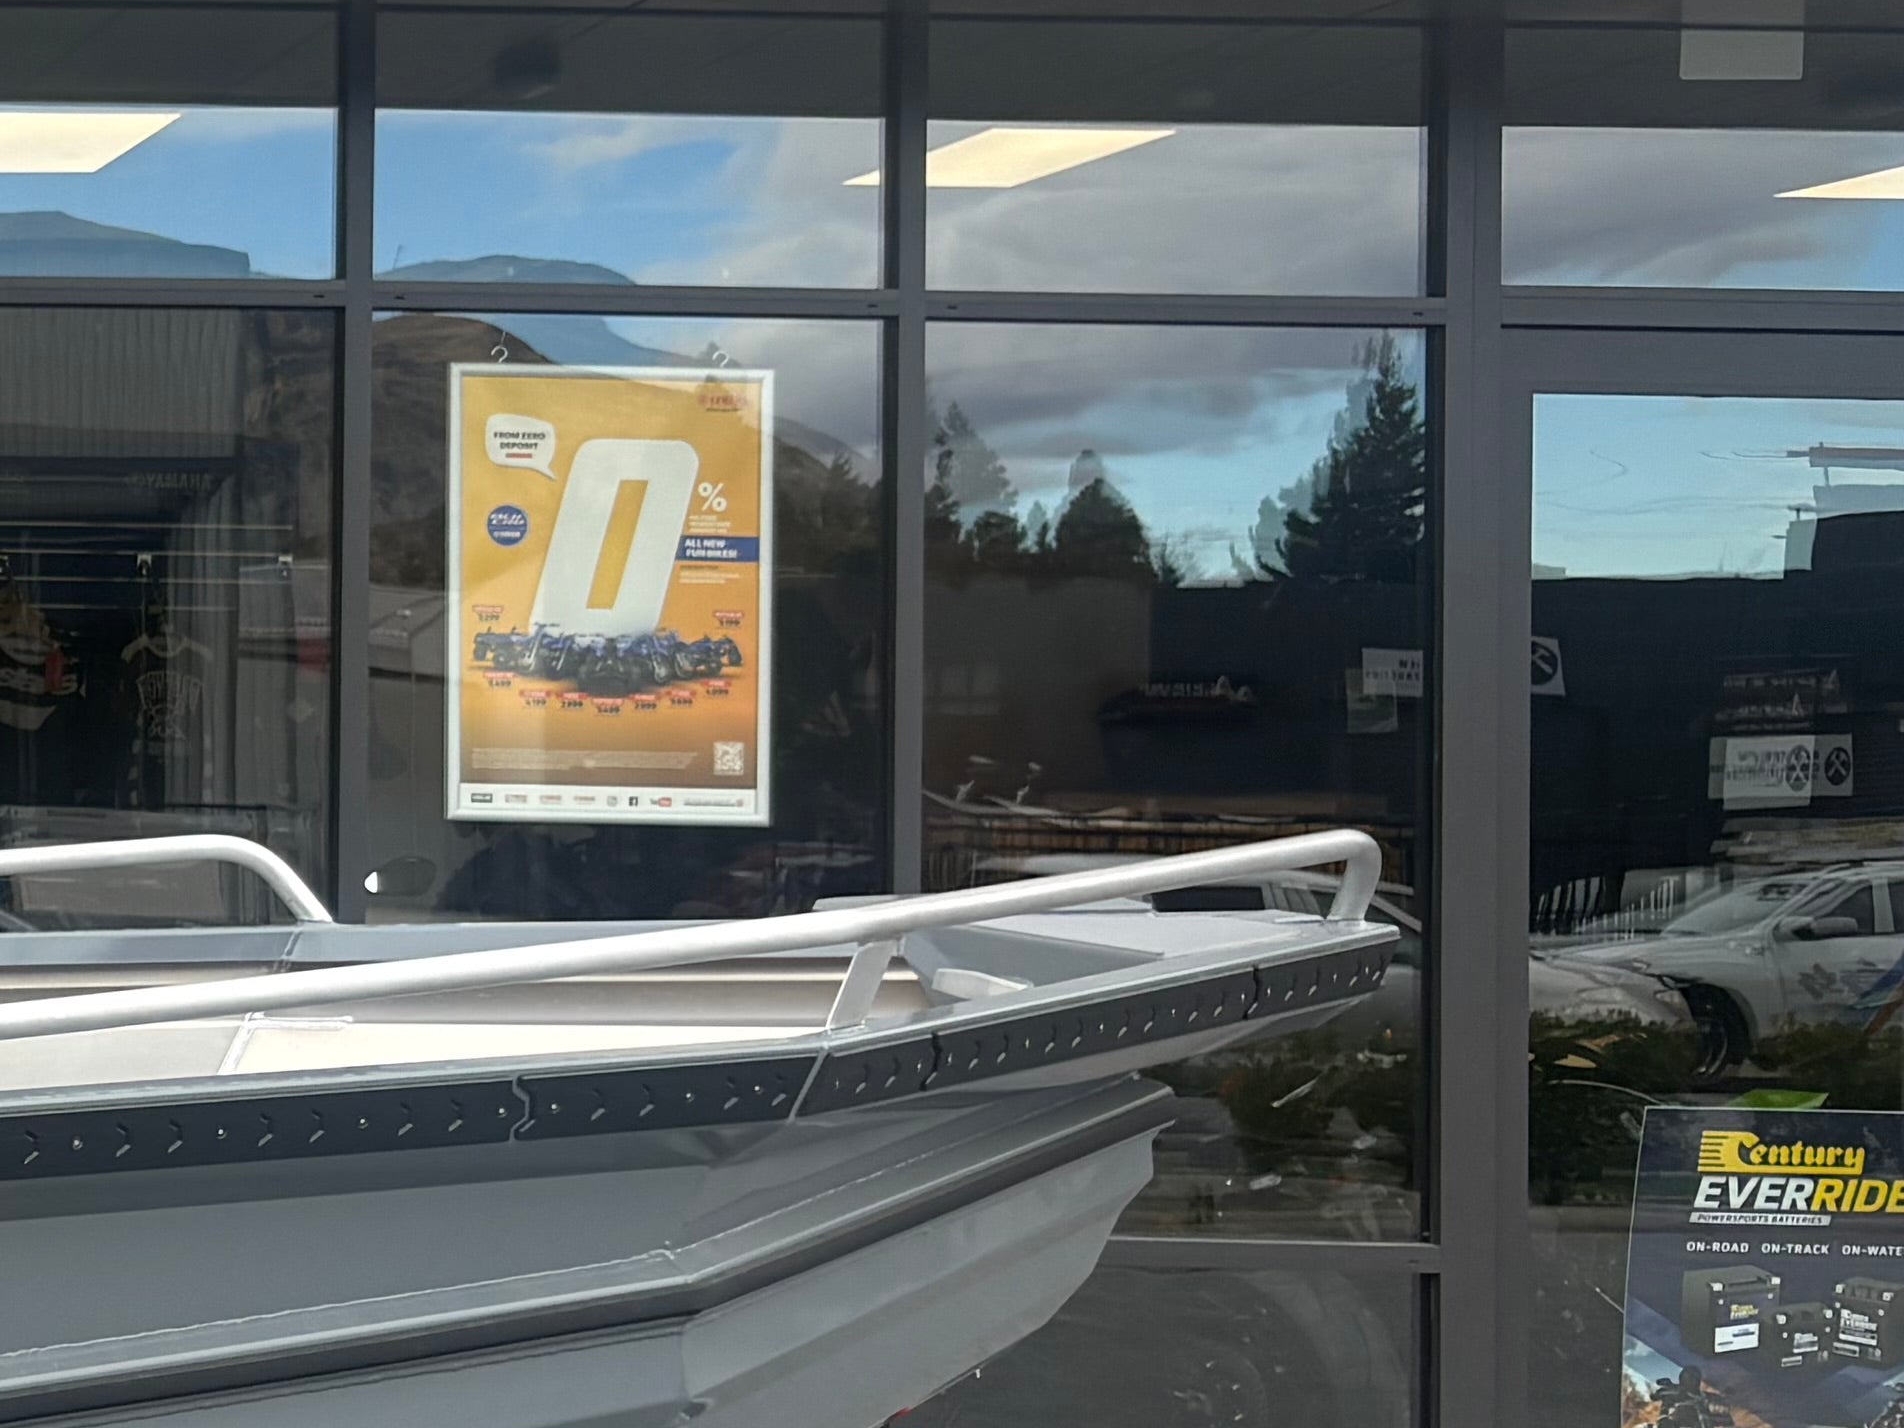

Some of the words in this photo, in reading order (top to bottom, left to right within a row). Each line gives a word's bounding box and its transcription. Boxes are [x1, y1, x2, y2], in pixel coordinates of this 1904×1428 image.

[1698, 1130, 1866, 1175] Century
[1697, 1214, 1769, 1224] POWERSPORTS
[1771, 1215, 1823, 1225] BATTERIES
[1686, 1240, 1750, 1254] ON-ROAD
[1761, 1242, 1830, 1255] ON-TRACK
